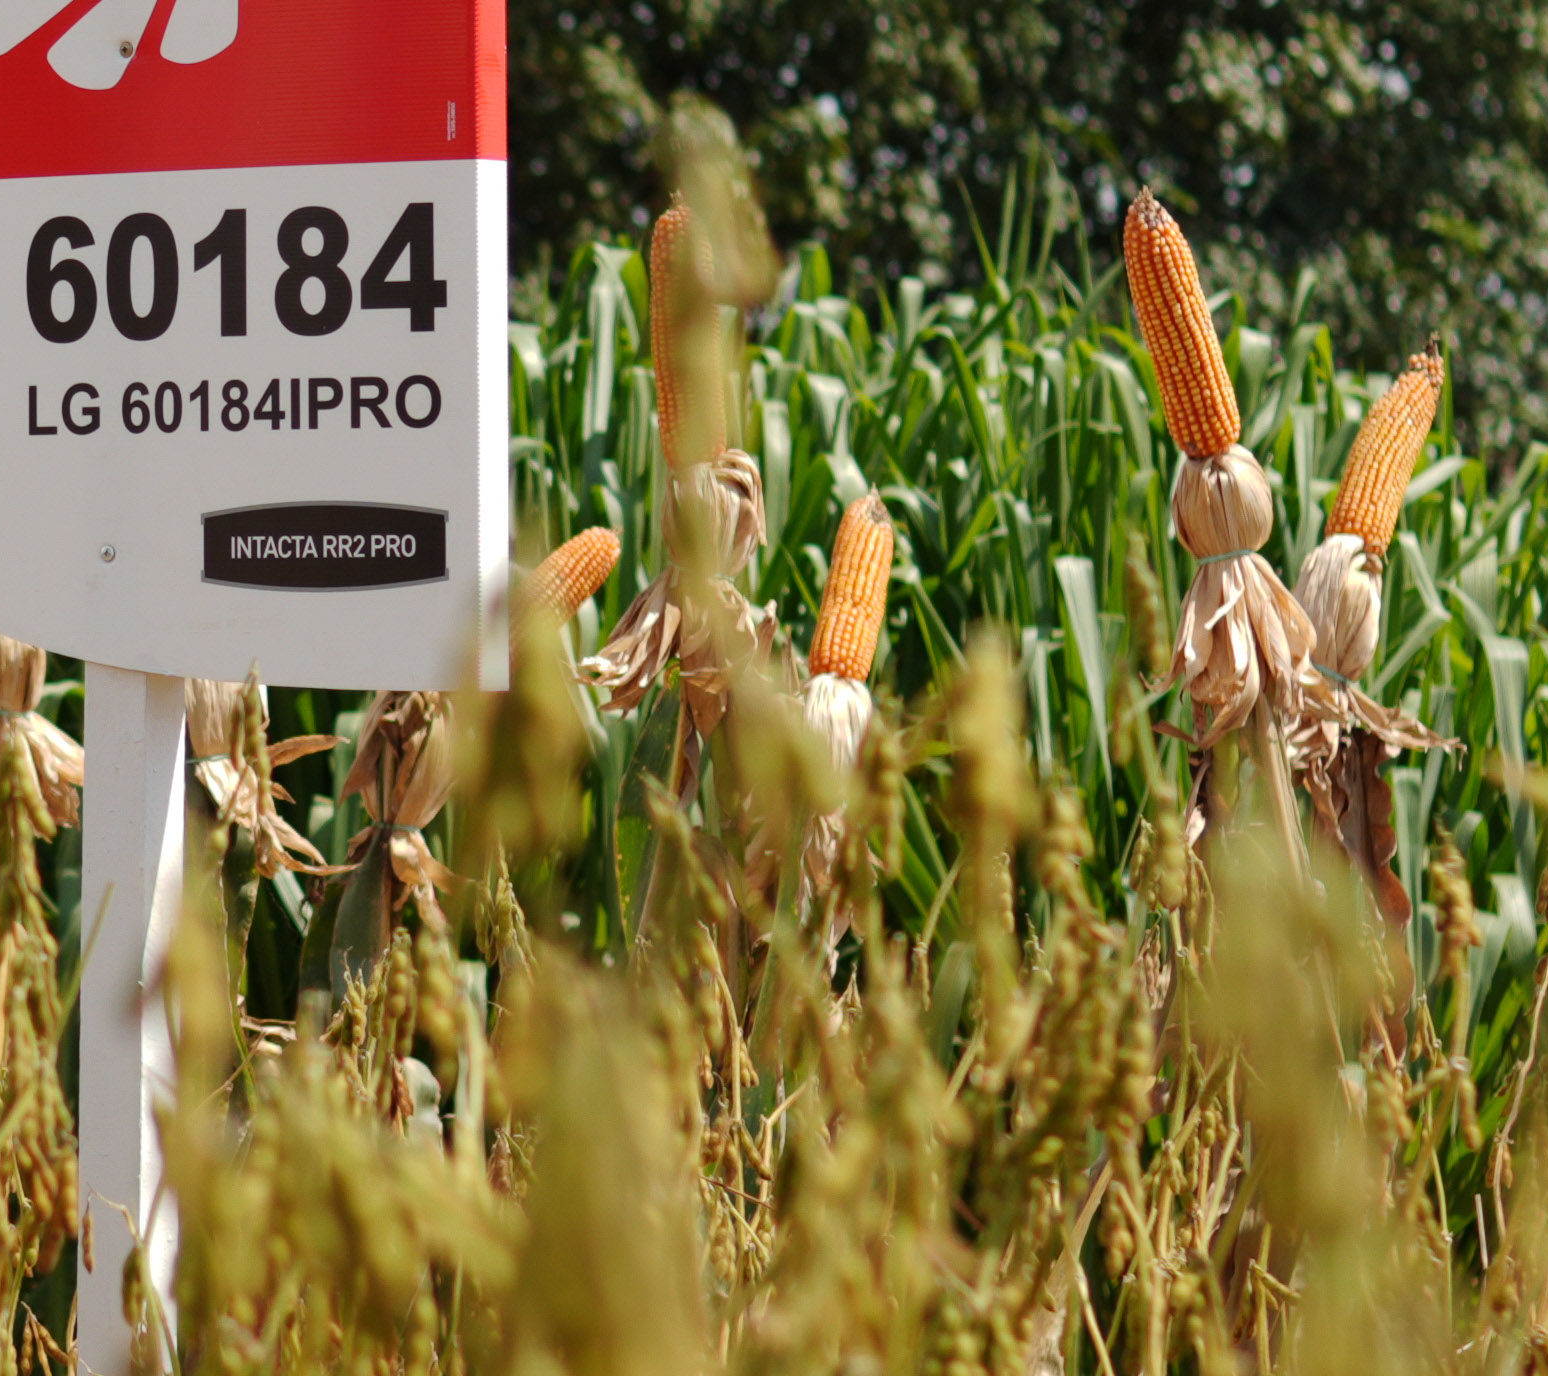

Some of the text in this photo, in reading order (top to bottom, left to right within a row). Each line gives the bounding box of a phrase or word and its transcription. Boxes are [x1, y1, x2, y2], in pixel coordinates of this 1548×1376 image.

[25, 202, 447, 344] 60184
[27, 374, 442, 436] LG 60184IPRO
[230, 534, 417, 560] INTACTA RR2 PRO
